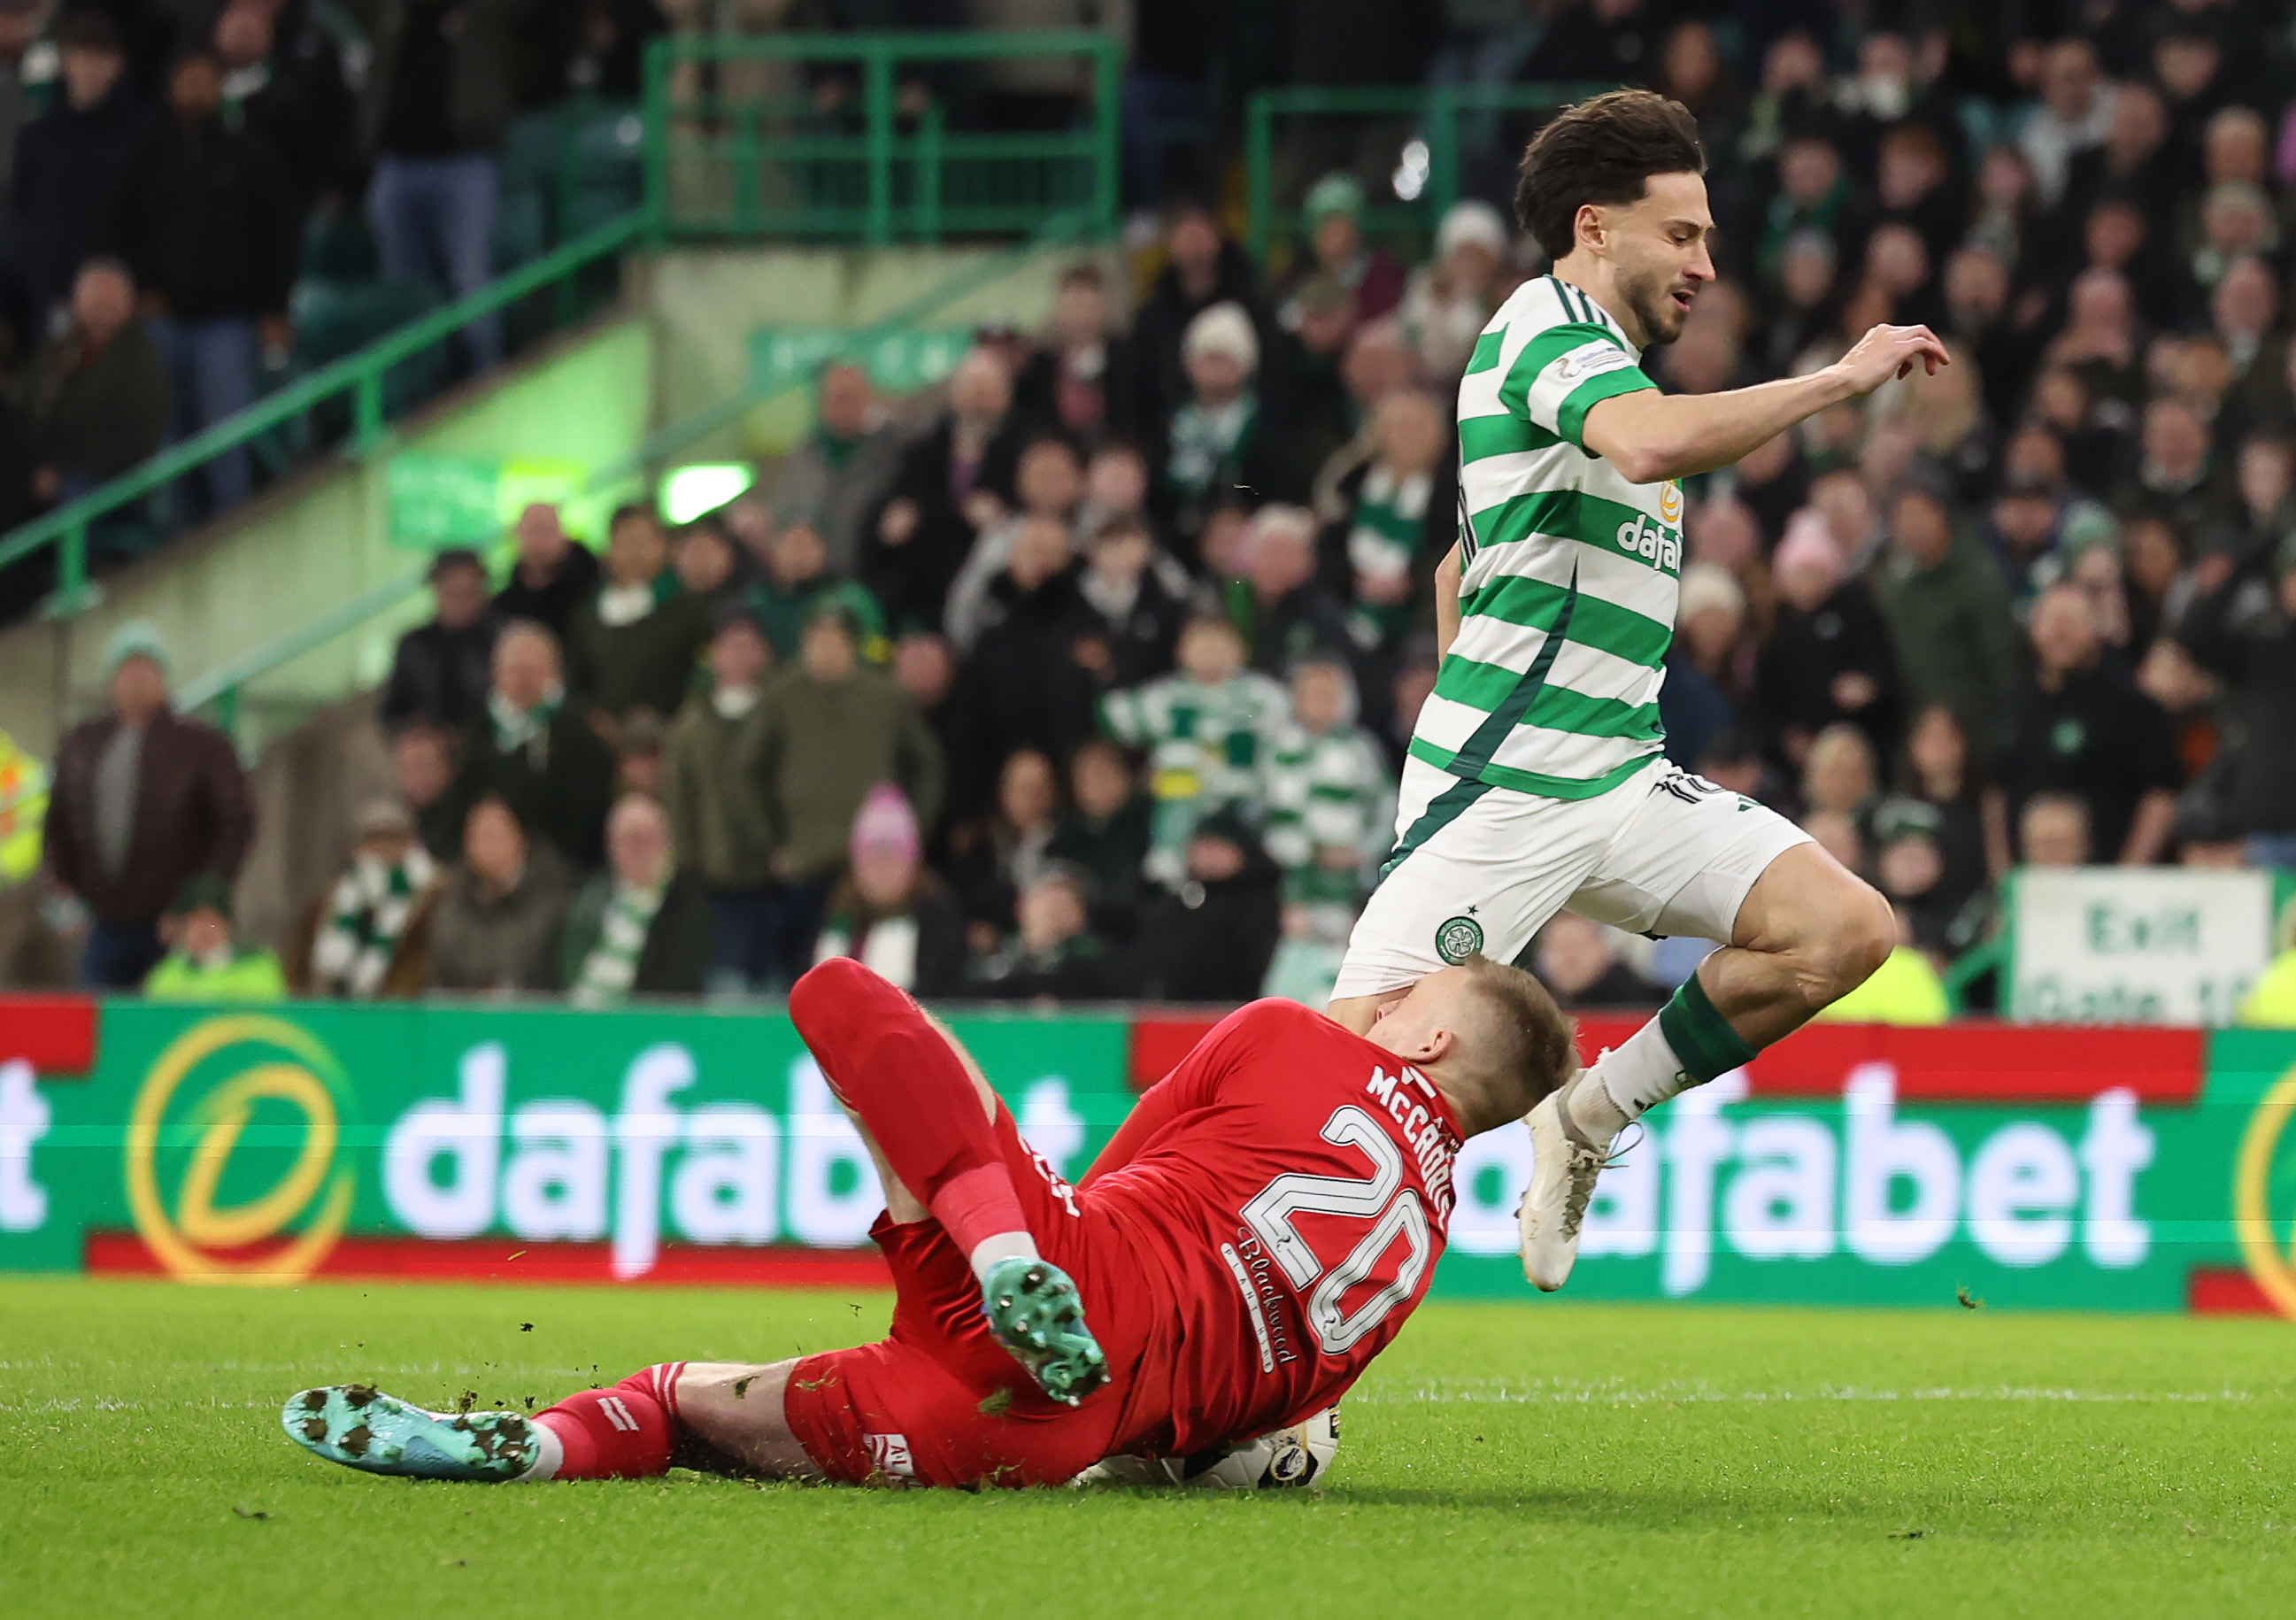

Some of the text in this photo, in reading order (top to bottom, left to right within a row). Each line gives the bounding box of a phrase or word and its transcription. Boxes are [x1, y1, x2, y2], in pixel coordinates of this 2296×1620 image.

[2084, 901, 2201, 953] Exit
[381, 1040, 1086, 1282] dafabt
[1240, 1105, 1430, 1355] 20
[1237, 1226, 1298, 1364] Blackwood
